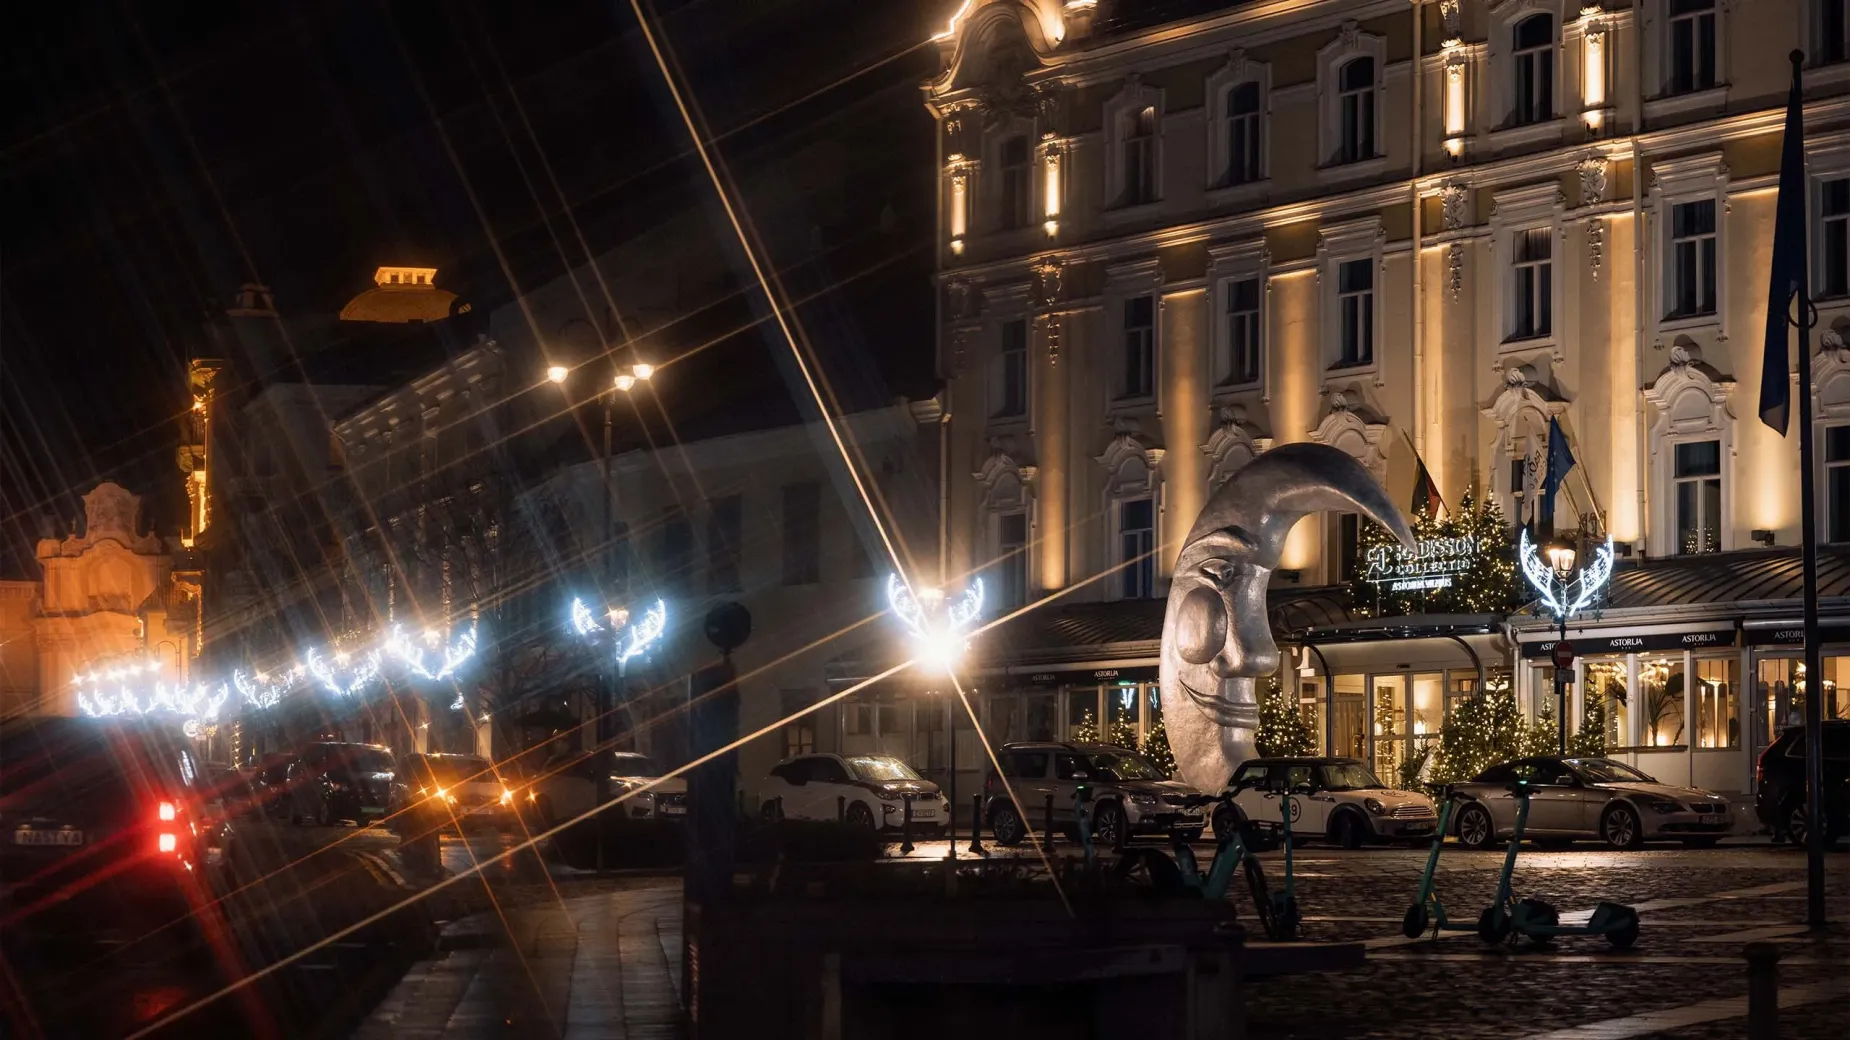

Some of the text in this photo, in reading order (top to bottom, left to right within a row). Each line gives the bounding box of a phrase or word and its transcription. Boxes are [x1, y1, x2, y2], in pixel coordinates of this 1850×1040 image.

[1681, 633, 1717, 643] ASTORIJA
[1774, 630, 1804, 639] ASTORI
[1609, 638, 1643, 647] ASTORIJA
[1094, 670, 1119, 678] ASTORIJA
